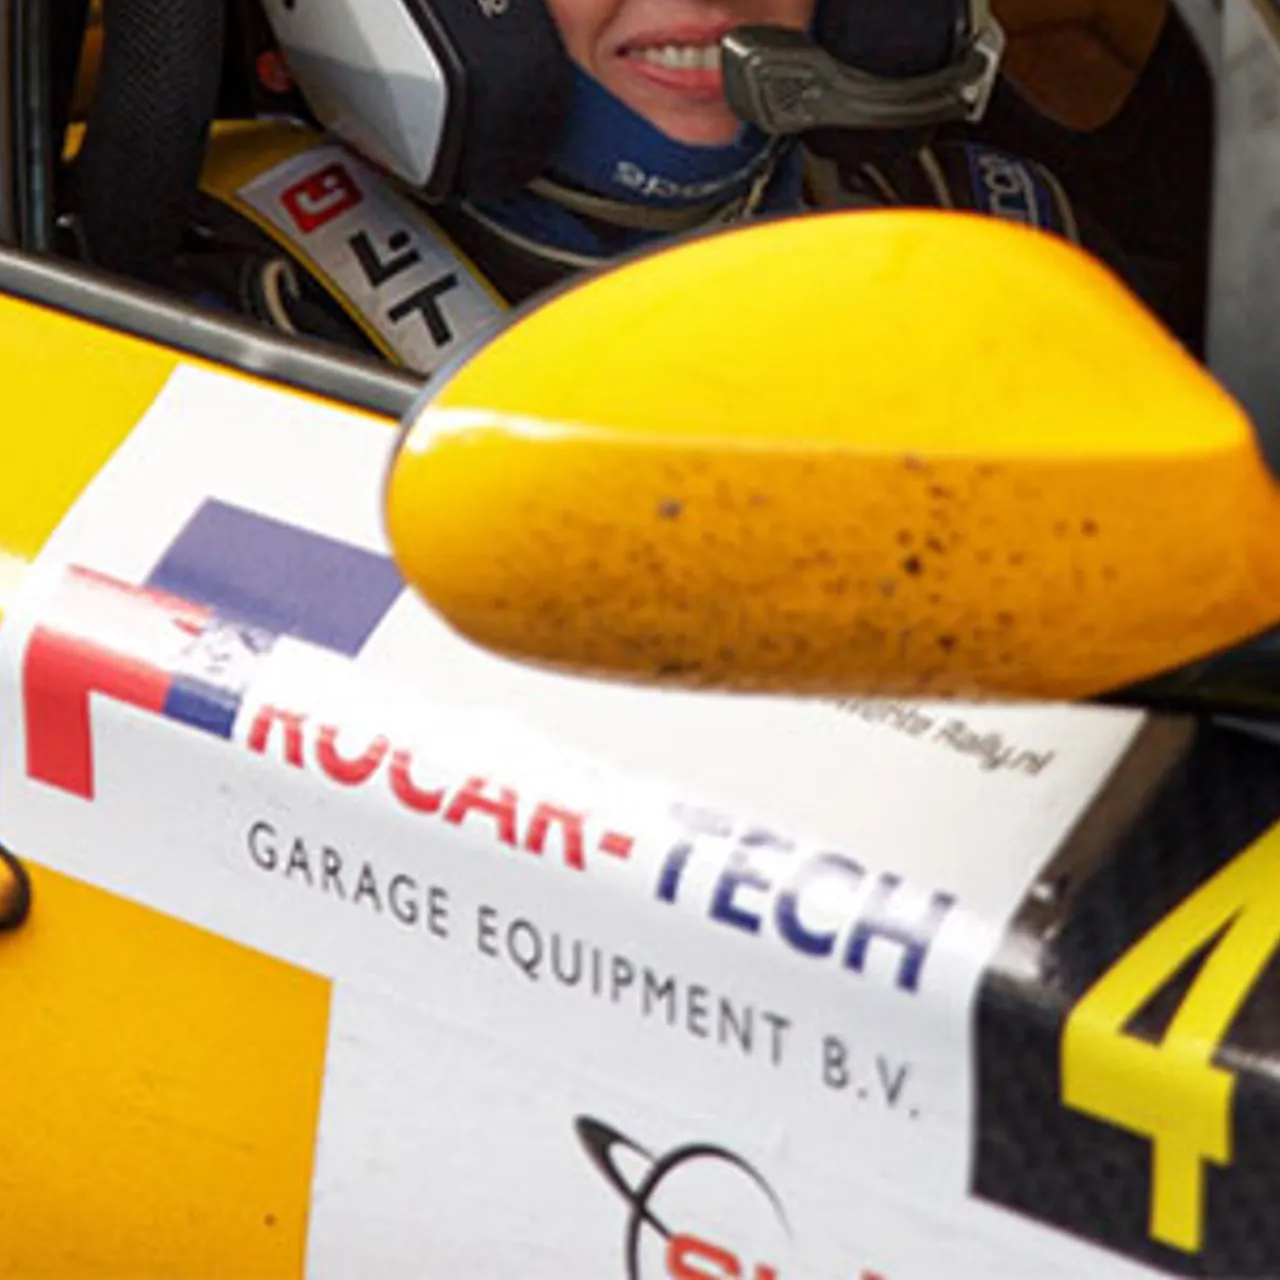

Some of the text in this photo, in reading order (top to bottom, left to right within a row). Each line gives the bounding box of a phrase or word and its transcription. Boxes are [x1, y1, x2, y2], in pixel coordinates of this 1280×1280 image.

[246, 819, 923, 1121] GARAGE EQUIPMENT B.V.
